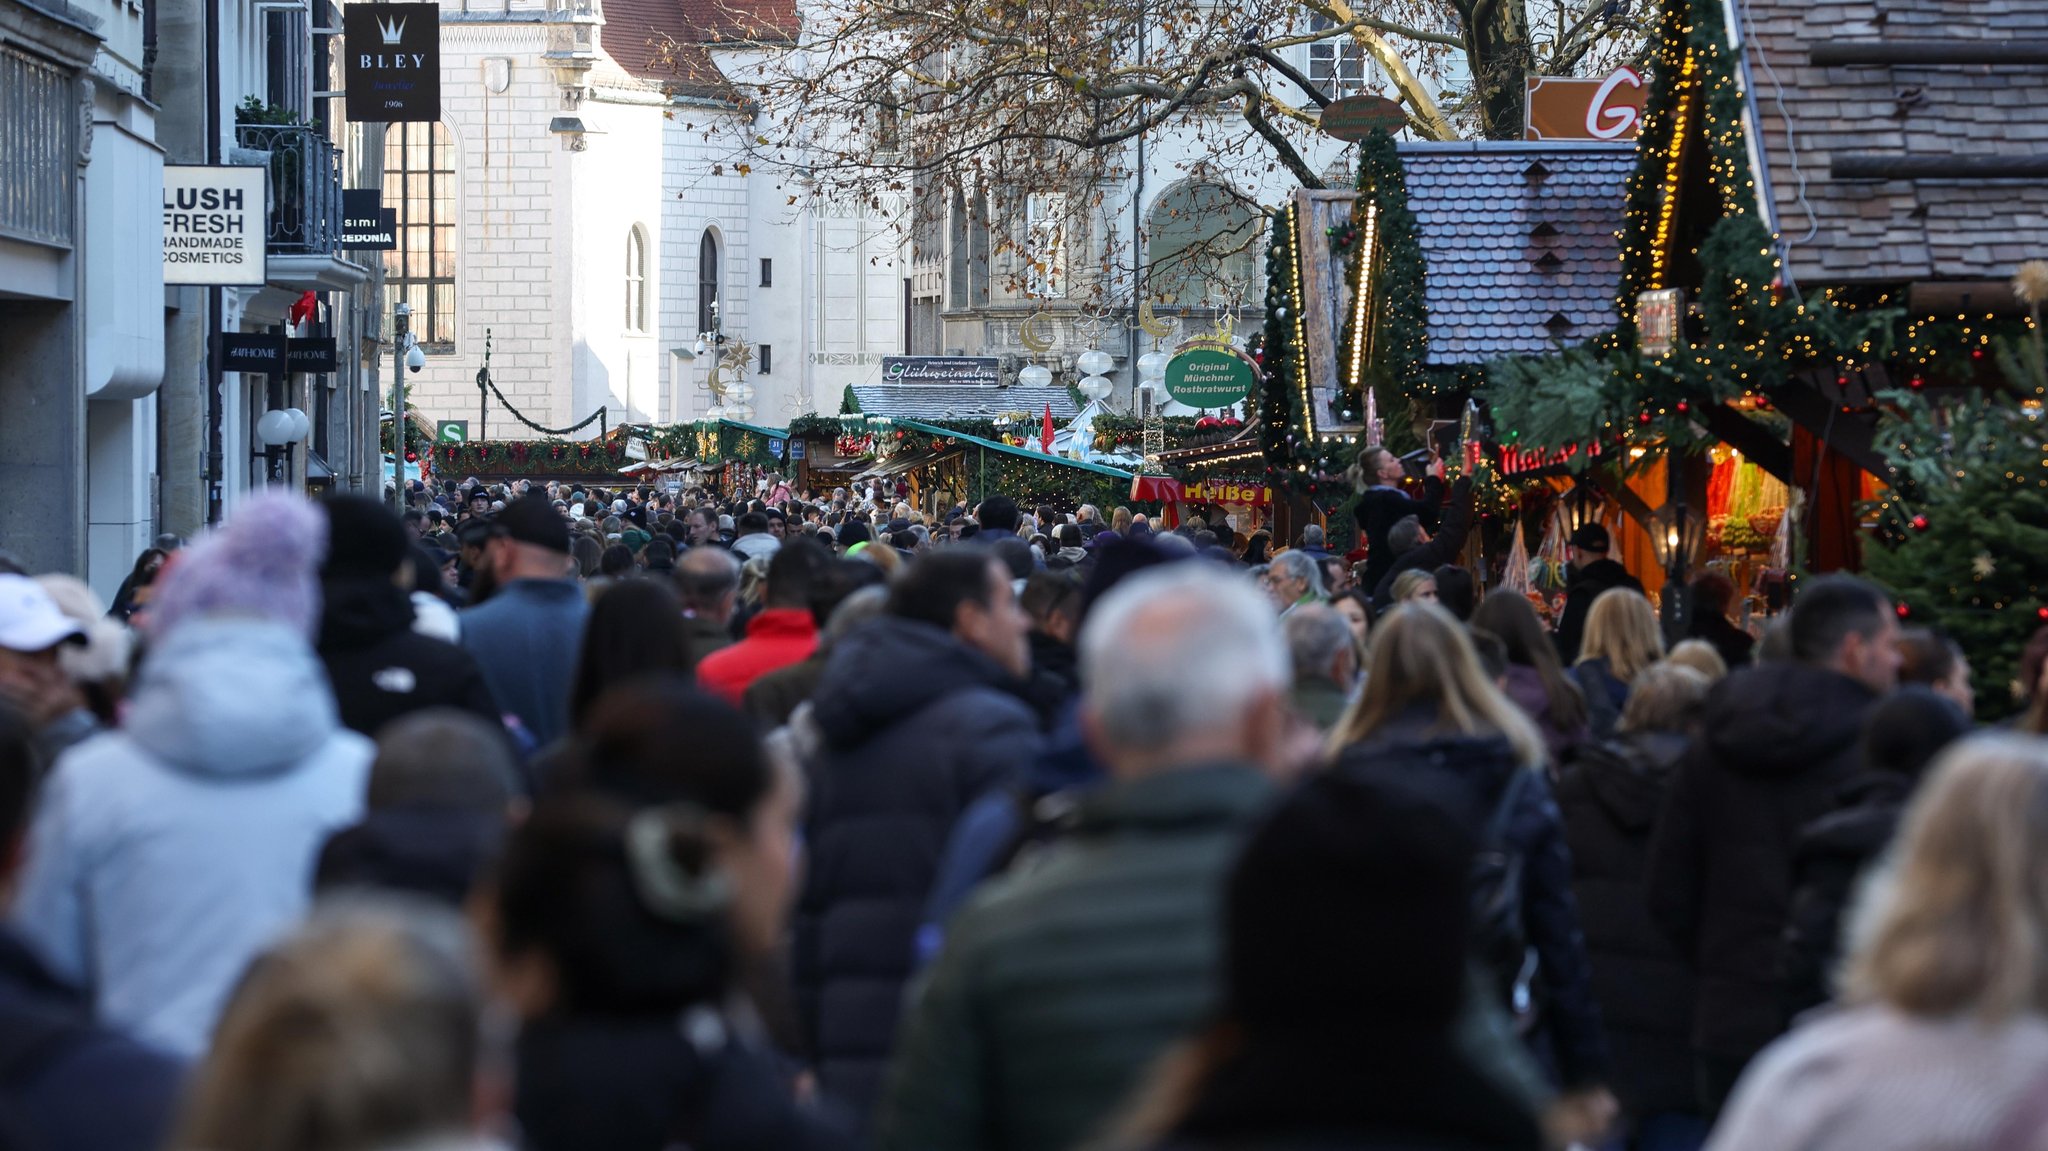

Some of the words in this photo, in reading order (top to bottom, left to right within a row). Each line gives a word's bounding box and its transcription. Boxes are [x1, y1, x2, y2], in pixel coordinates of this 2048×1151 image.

[360, 53, 425, 69] BLEY
[384, 100, 403, 109] 1906
[1586, 65, 1641, 139] G
[163, 187, 243, 210] LUSH
[163, 213, 243, 233] FRESH
[245, 347, 277, 359] HOME
[886, 361, 996, 381] Glühweinalm
[1189, 363, 1229, 373] Original
[1183, 374, 1236, 383] Münchner
[1173, 384, 1247, 394] Rostbratwurst
[444, 424, 461, 442] S
[1185, 482, 1256, 501] Heiße
